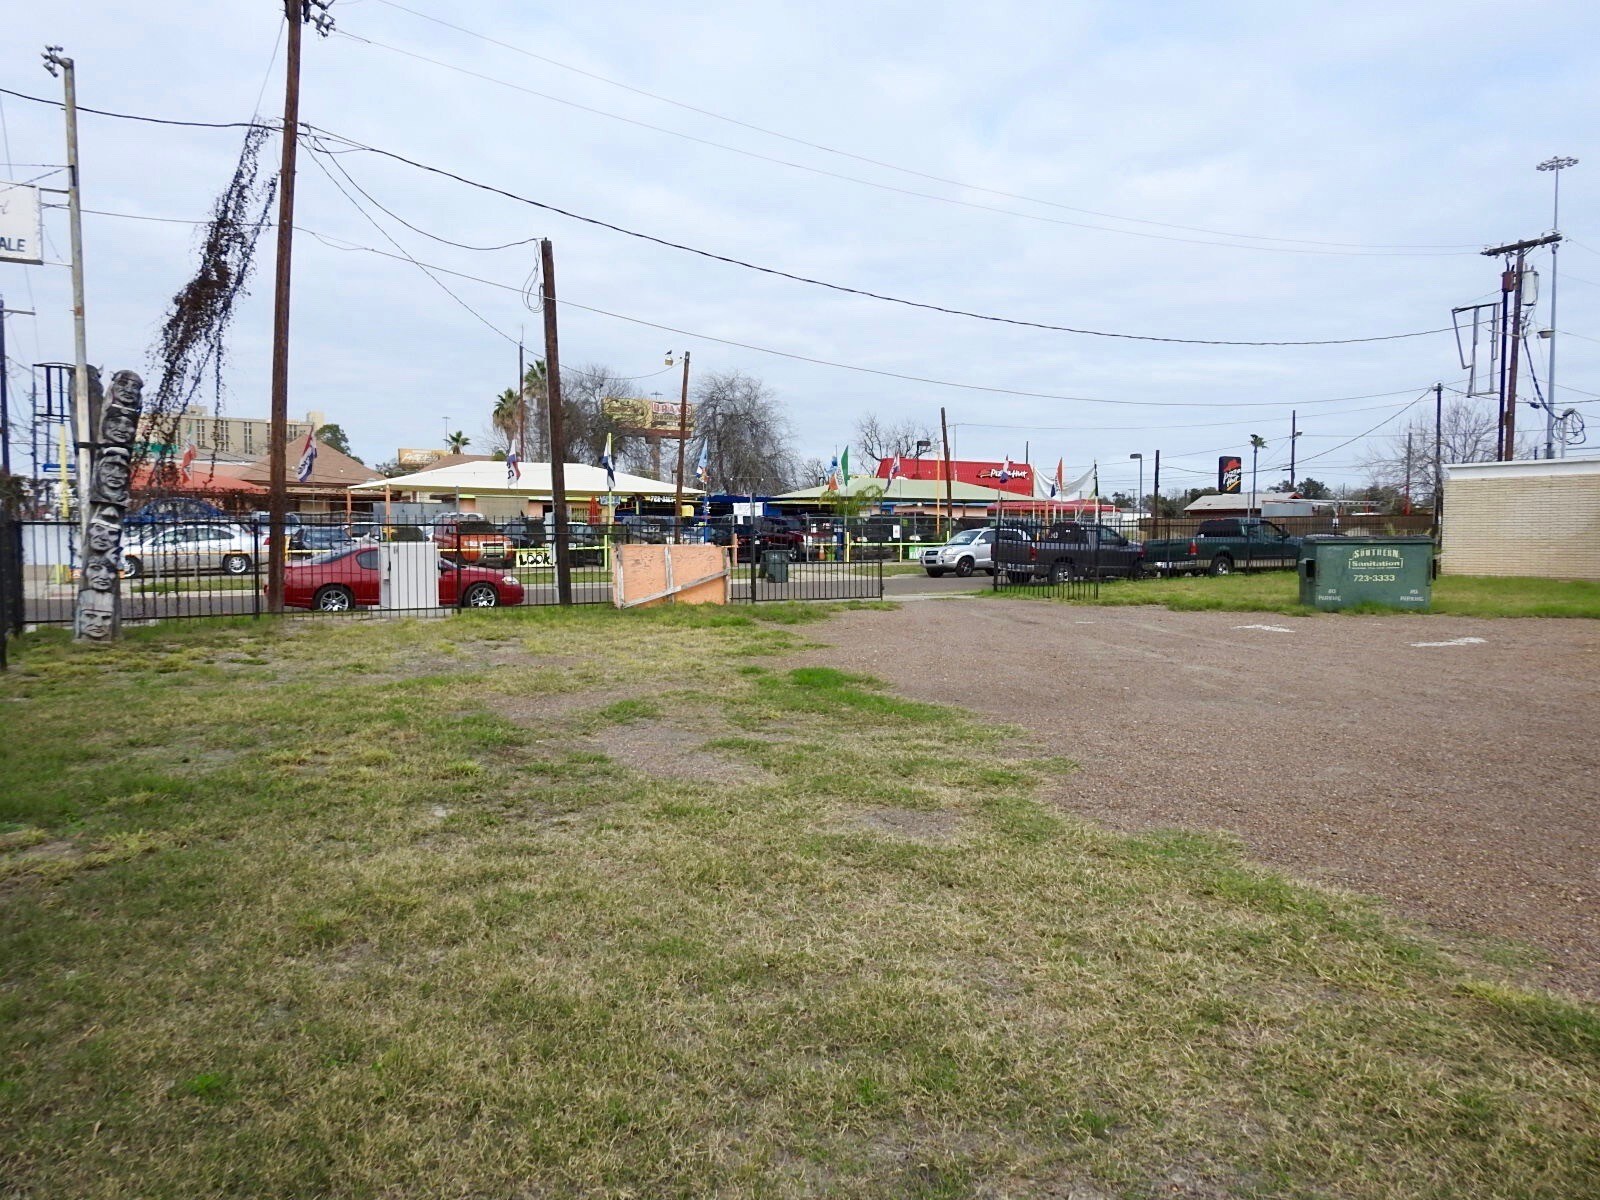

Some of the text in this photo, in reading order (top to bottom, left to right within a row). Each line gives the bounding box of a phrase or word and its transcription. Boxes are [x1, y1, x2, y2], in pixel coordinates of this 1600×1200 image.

[991, 469, 1028, 478] Piza Hut
[1353, 549, 1399, 558] SOUTHERN
[1353, 574, 1396, 582] 723-3333
